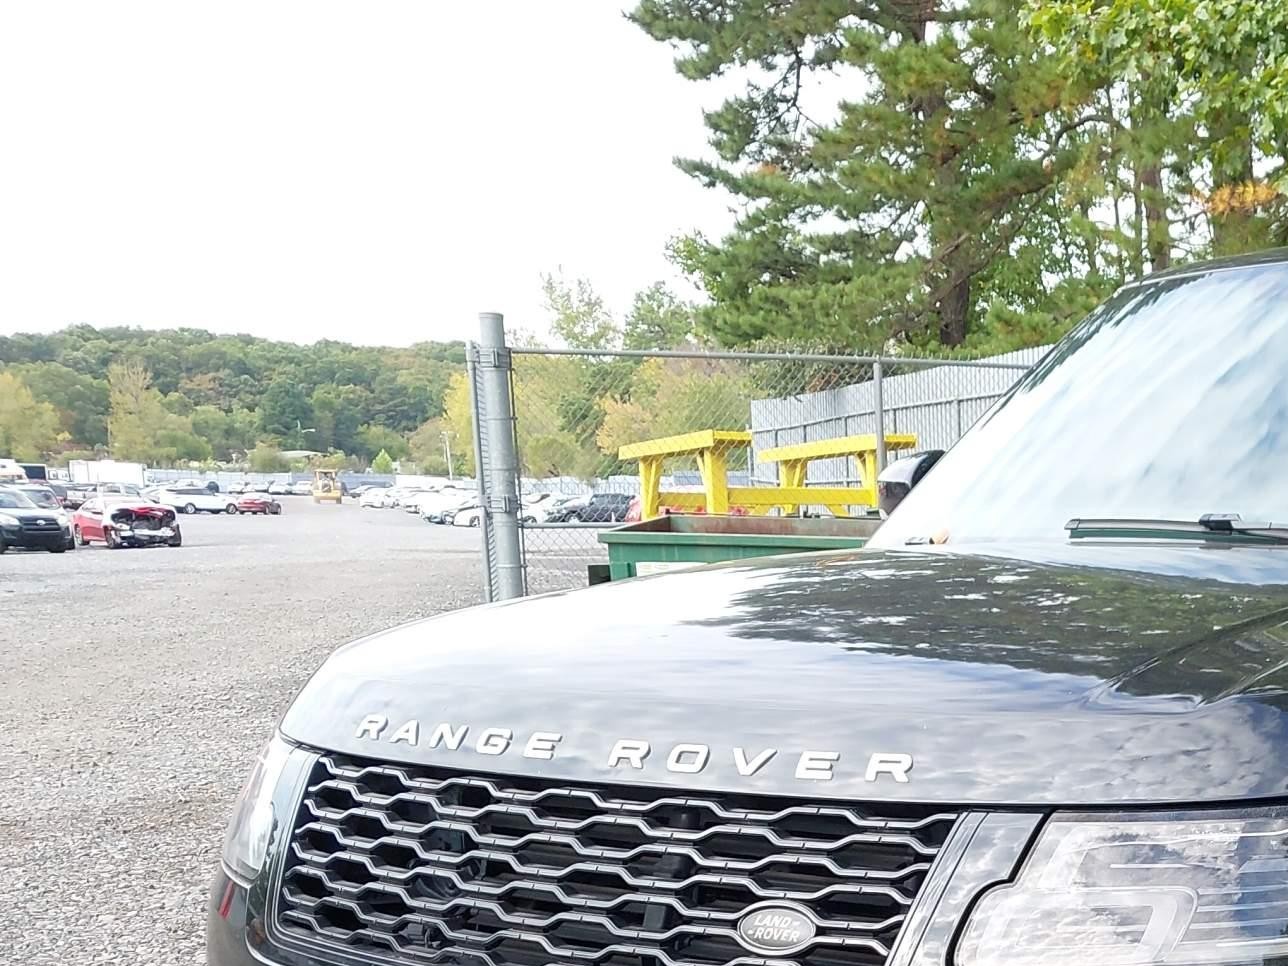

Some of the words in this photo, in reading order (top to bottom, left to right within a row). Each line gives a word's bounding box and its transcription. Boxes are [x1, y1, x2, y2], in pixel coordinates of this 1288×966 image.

[355, 713, 563, 761] RANGE
[607, 738, 914, 784] ROVER
[753, 914, 793, 928] LAND
[753, 927, 800, 943] ROVER
